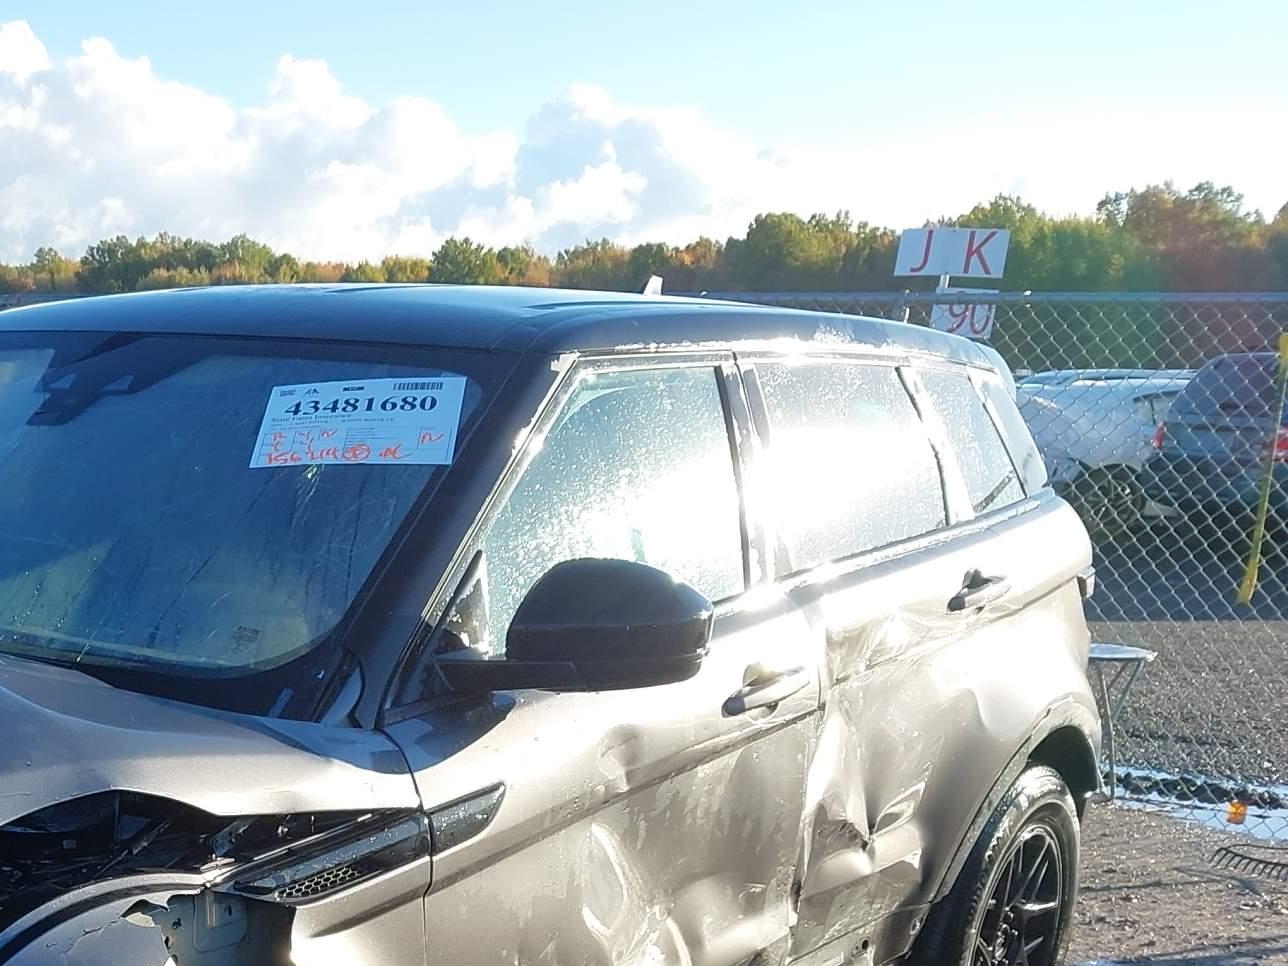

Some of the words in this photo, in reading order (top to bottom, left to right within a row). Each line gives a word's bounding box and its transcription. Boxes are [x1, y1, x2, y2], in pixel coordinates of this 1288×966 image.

[909, 229, 934, 273] J
[963, 229, 998, 275] K
[284, 395, 438, 417] 43481680
